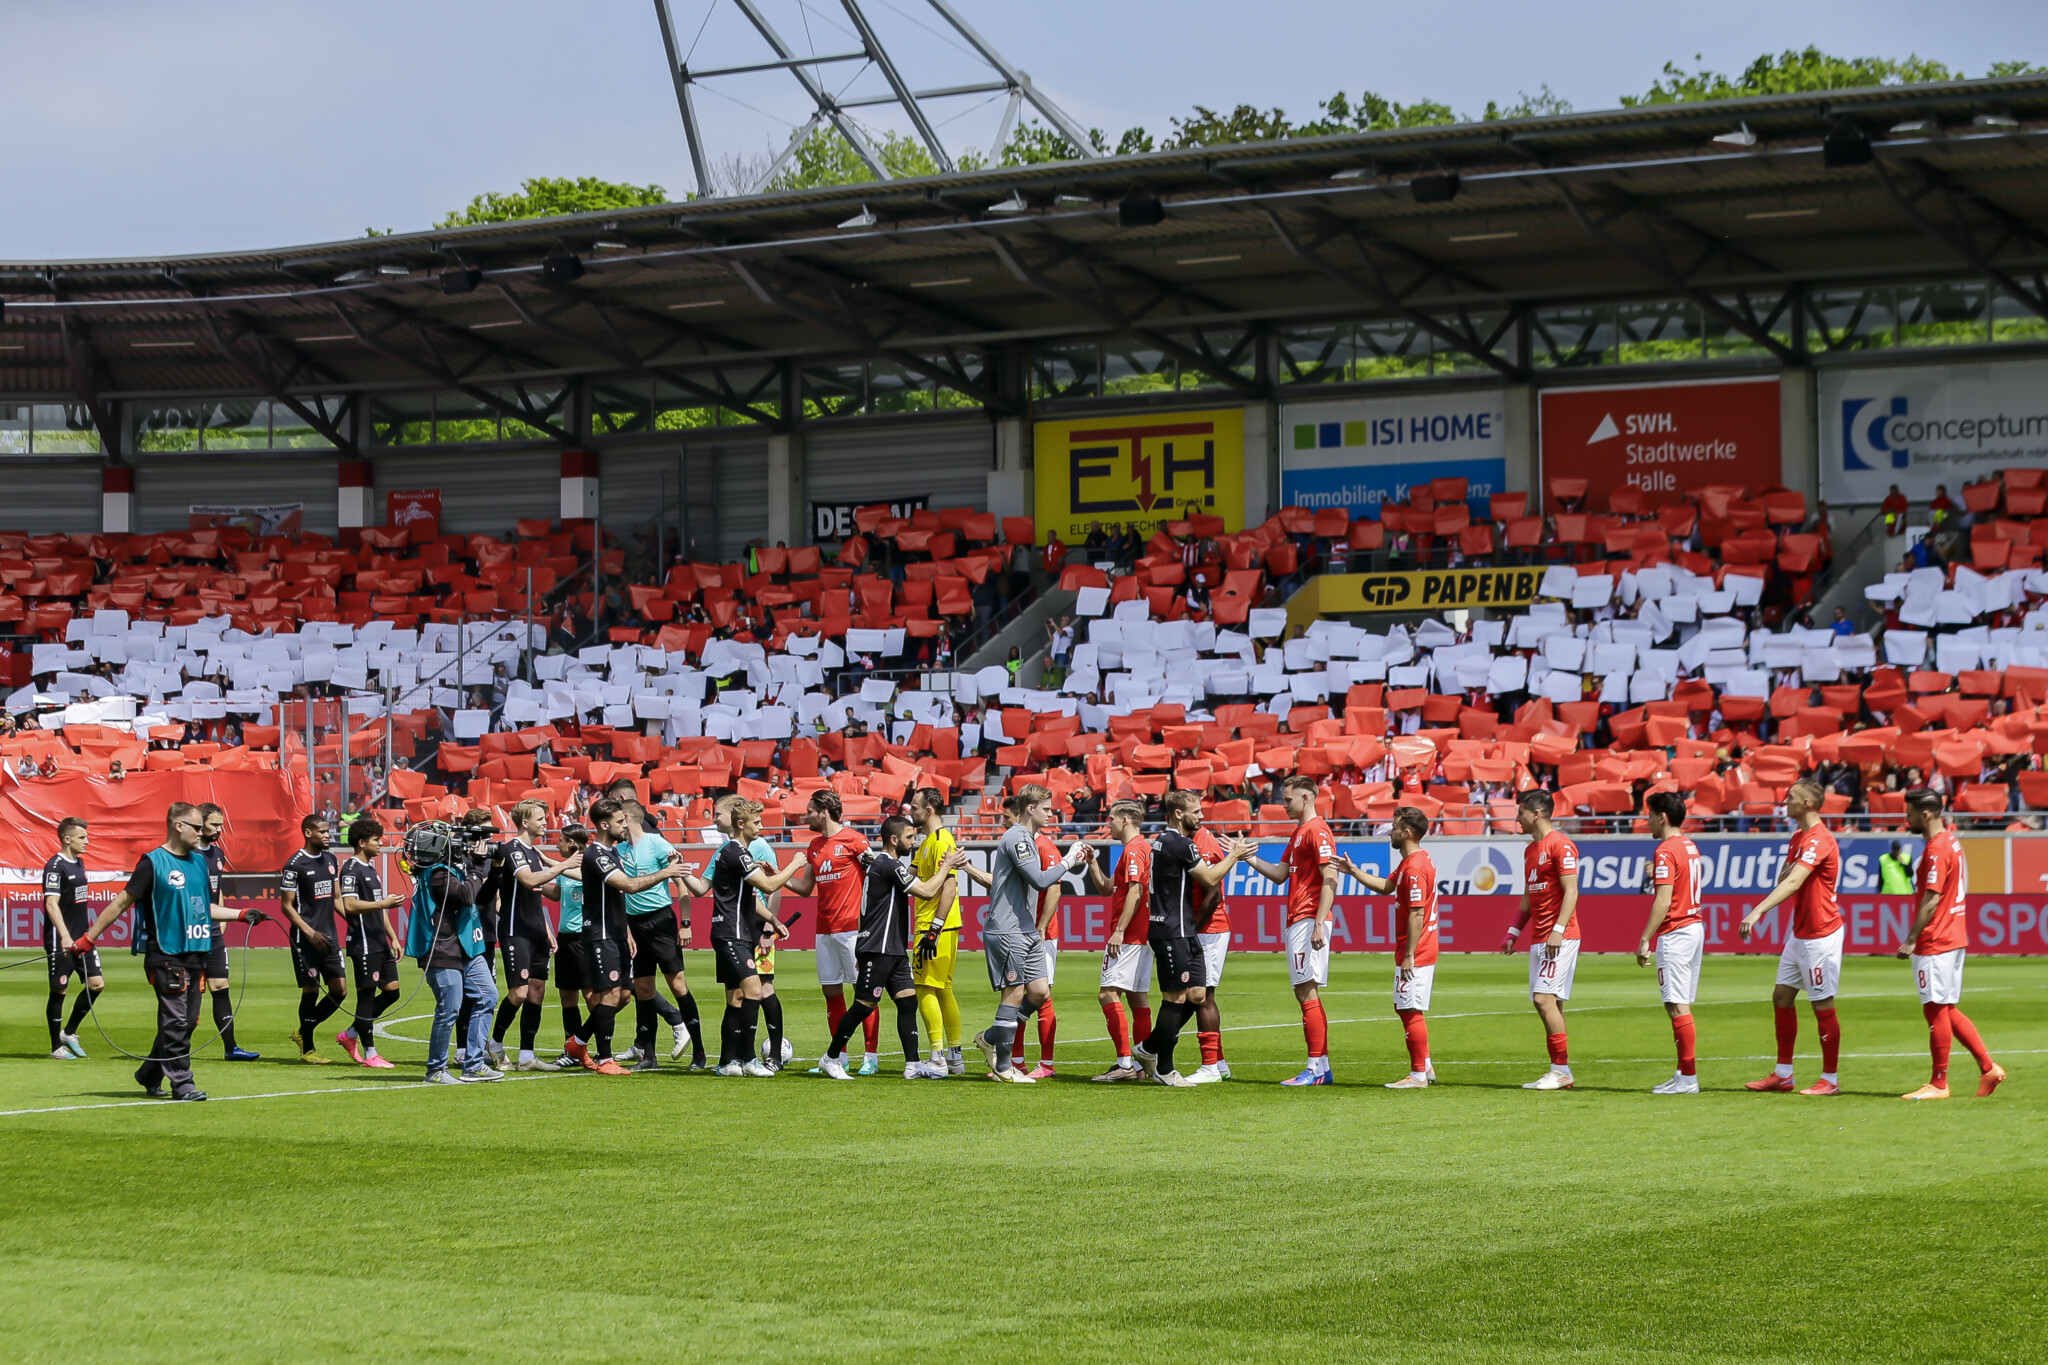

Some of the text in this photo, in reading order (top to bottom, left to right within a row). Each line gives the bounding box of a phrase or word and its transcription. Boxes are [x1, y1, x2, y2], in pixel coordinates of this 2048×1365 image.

[1372, 412, 1491, 446] ISI HOME
[1626, 413, 1678, 435] SWH.
[1626, 439, 1737, 465] Stadtwerke
[1626, 470, 1677, 492] Halle
[1294, 482, 1387, 508] Immobilien
[1577, 855, 1646, 889] nsu
[8, 890, 46, 901] Stadt
[186, 924, 211, 940] HOS
[1294, 952, 1306, 970] 17
[1539, 959, 1557, 979] 20
[1395, 975, 1408, 994] 22
[1808, 967, 1824, 987] 18
[1918, 969, 1927, 989] 8
